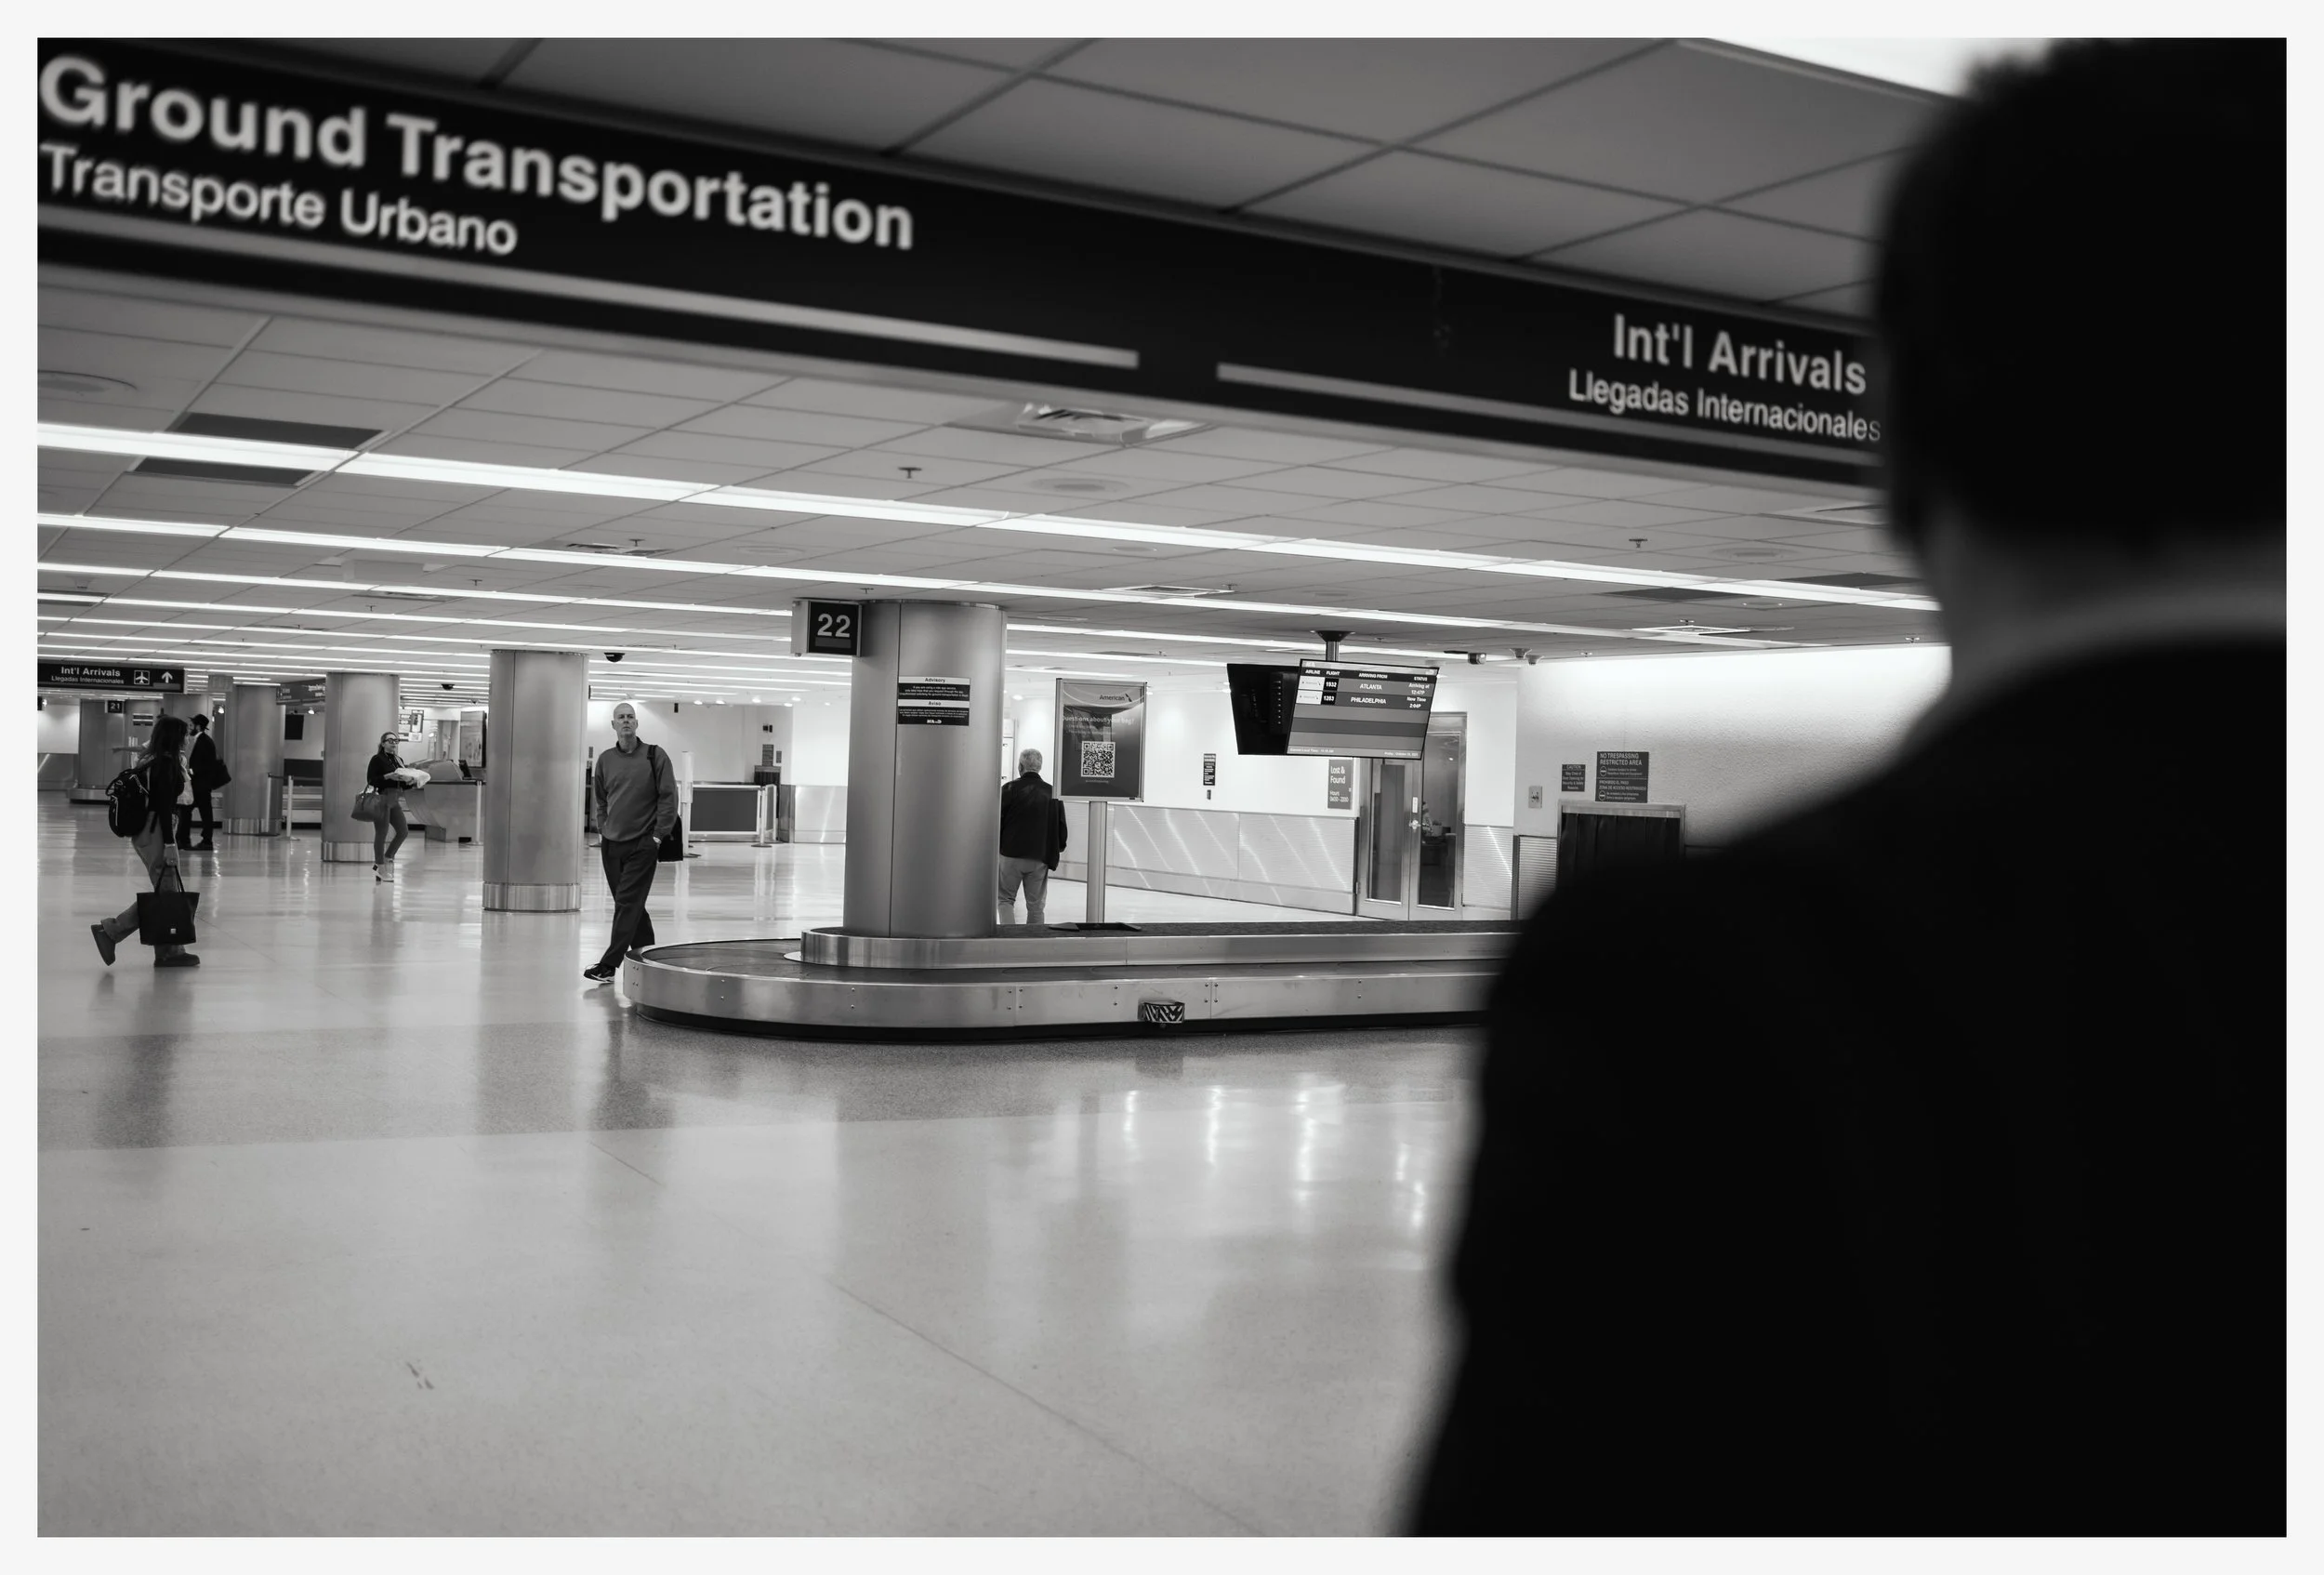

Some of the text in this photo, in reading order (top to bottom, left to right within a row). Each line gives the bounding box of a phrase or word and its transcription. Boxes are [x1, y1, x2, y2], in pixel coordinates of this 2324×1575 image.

[36, 53, 915, 251] Ground Transportation
[37, 142, 519, 256] Transporte Urbano
[1612, 313, 1868, 395] Int'l Arrivals
[1568, 368, 1882, 443] Llegadas Internacionales
[817, 613, 851, 638] 22
[51, 675, 79, 683] Llegadas
[61, 667, 121, 677] Int'l Arrivals
[1330, 765, 1345, 774] Lost &
[1330, 775, 1345, 784] Found
